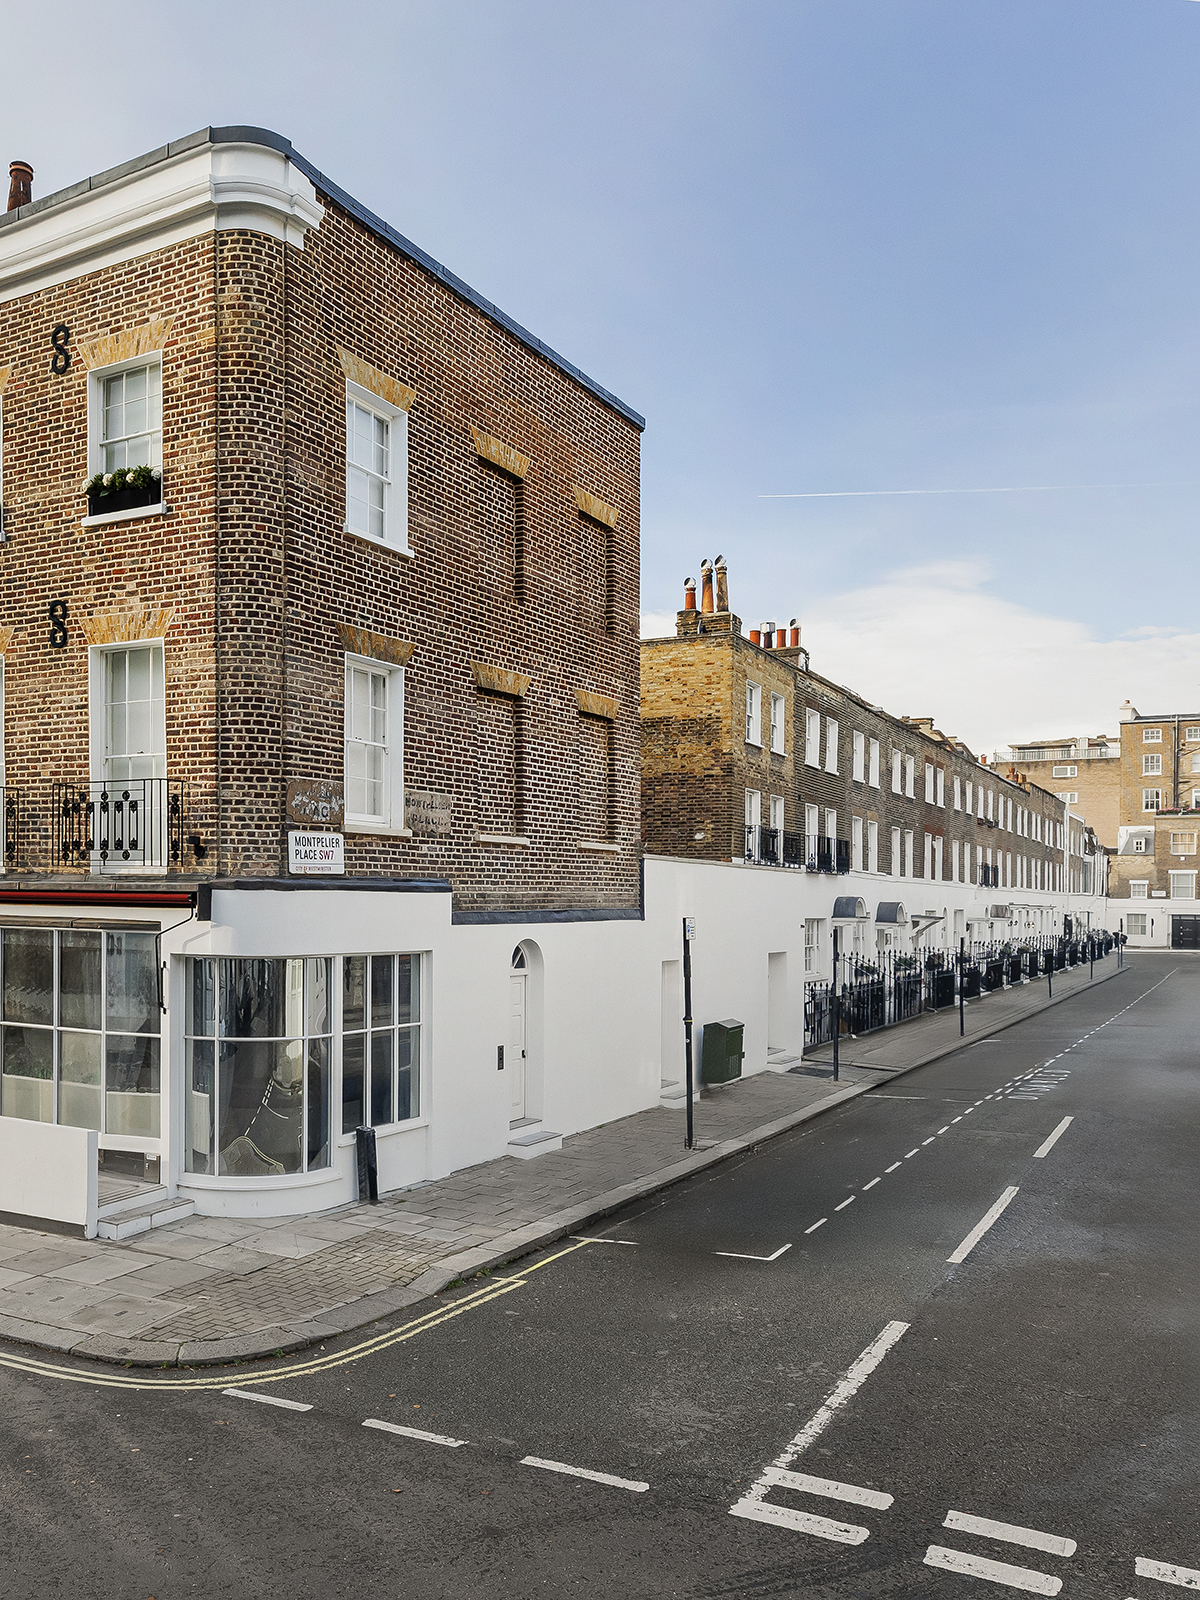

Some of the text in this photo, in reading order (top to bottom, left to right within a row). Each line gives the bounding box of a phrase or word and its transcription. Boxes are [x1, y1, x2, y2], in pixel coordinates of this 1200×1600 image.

[294, 836, 340, 848] MONTPELIER
[295, 849, 334, 860] PLACE SW7
